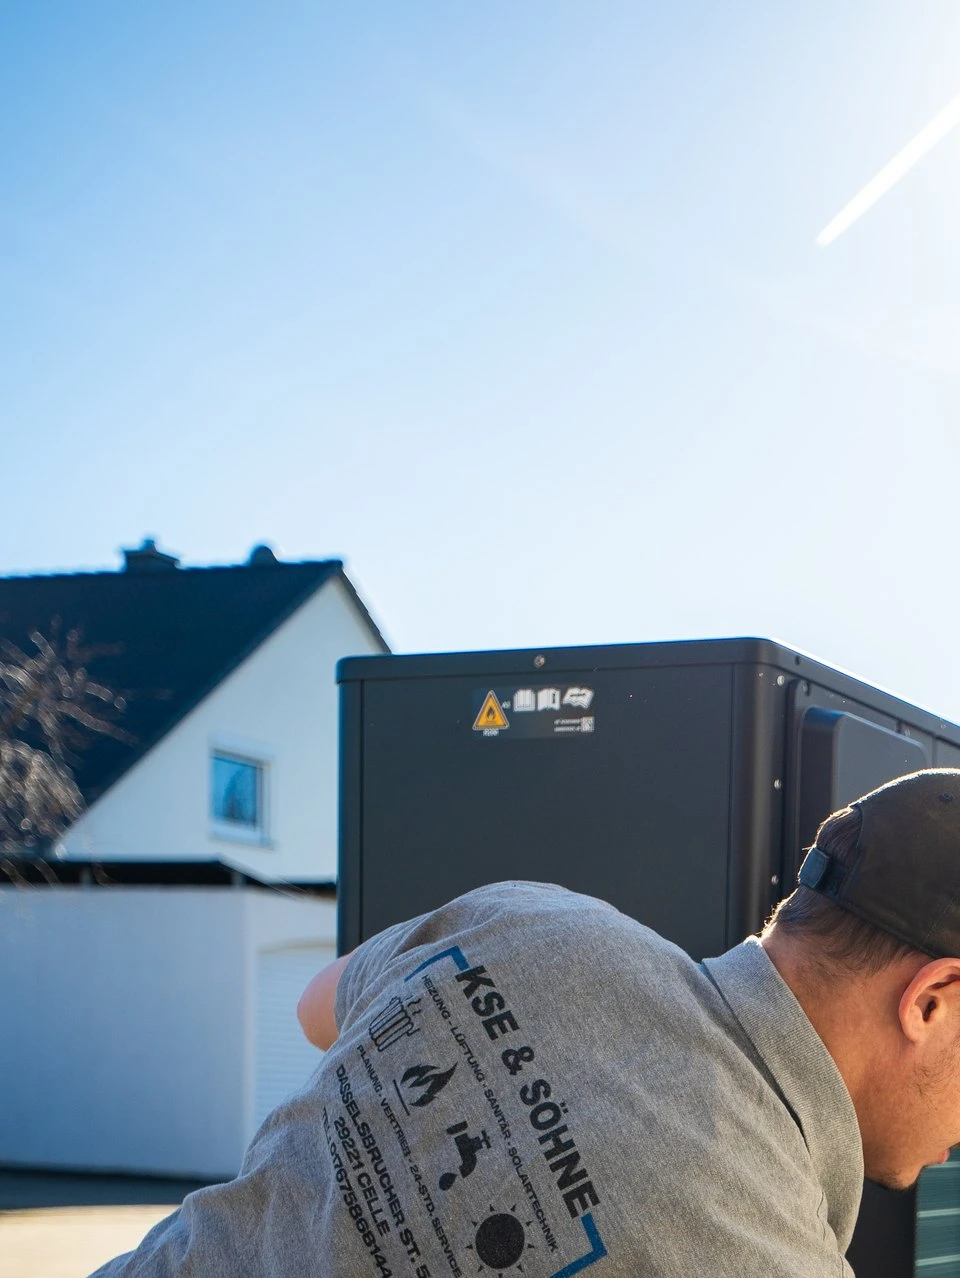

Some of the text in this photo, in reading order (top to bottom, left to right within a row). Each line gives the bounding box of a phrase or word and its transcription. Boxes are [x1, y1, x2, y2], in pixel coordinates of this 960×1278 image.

[334, 1116, 390, 1237] 29221 CELLE
[336, 1064, 405, 1228] DASSELSBRUCHER
[400, 1228, 420, 1263] ST.
[357, 1044, 382, 1093] PLANUNG
[380, 1098, 411, 1157] VERTRIEB
[410, 1164, 435, 1216] 24-STD.
[431, 1217, 462, 1278] SERVICE
[422, 974, 450, 1020] HEIZUNG
[450, 1026, 485, 1082] LÜFTUNG
[485, 1089, 511, 1140] SANITÄR
[508, 1147, 558, 1252] SOLARTECHNIK
[455, 965, 600, 1219] KSE & SÖHNE
